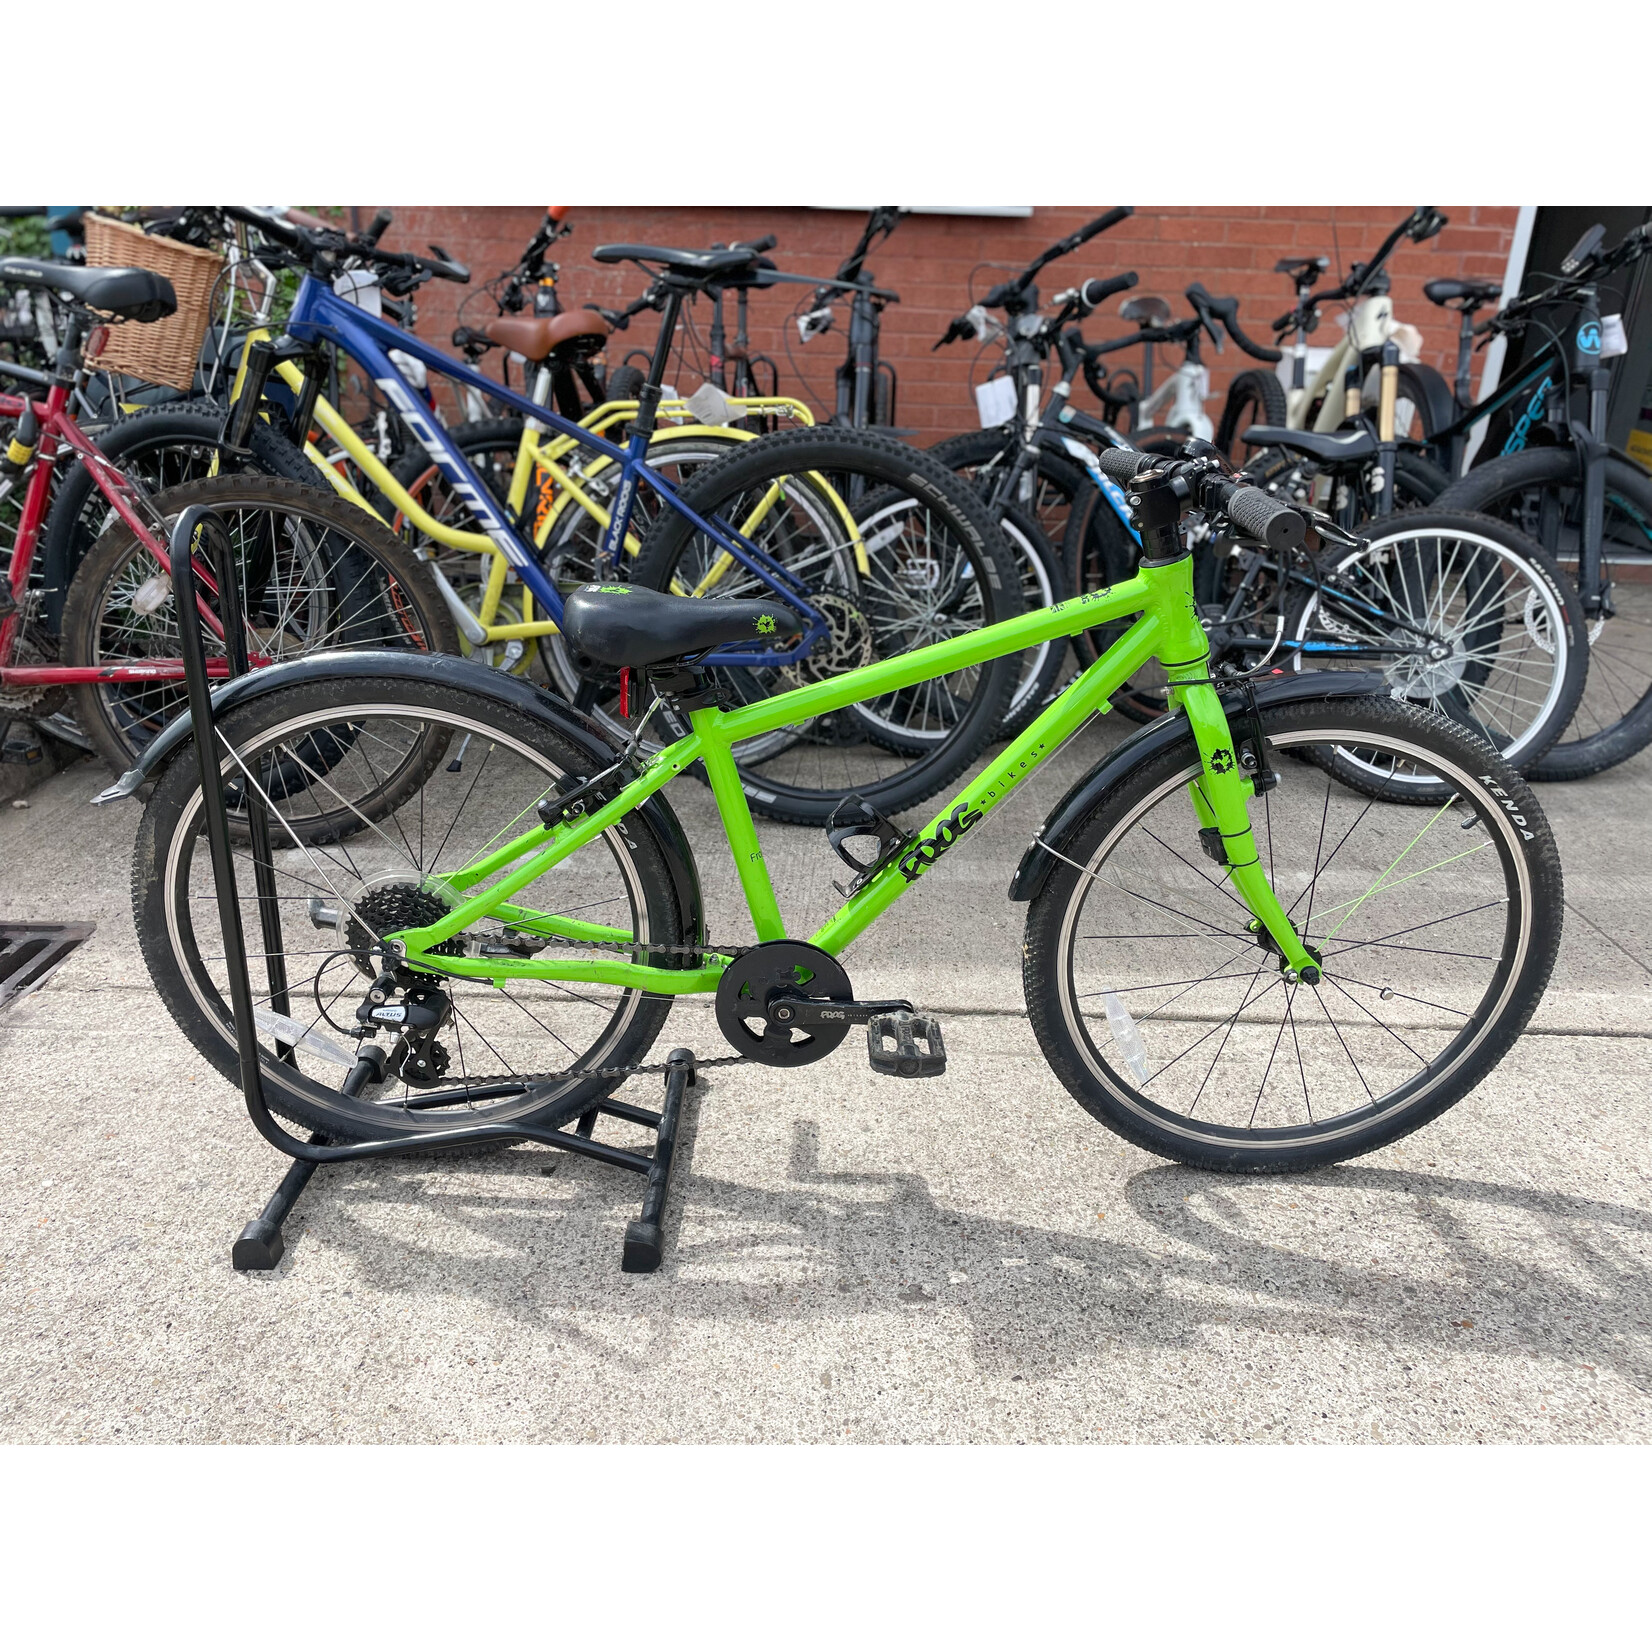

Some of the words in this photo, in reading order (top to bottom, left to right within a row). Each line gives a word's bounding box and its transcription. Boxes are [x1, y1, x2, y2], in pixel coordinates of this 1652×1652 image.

[1500, 376, 1553, 456] SPER
[375, 378, 529, 567] FORME
[608, 518, 624, 551] BLACK
[907, 473, 1002, 590] SCHWALBE
[987, 750, 1039, 798] bikes
[1478, 775, 1535, 841] KENDA
[750, 850, 763, 863] Fro
[899, 802, 984, 884] FROG
[820, 1010, 846, 1020] FROG
